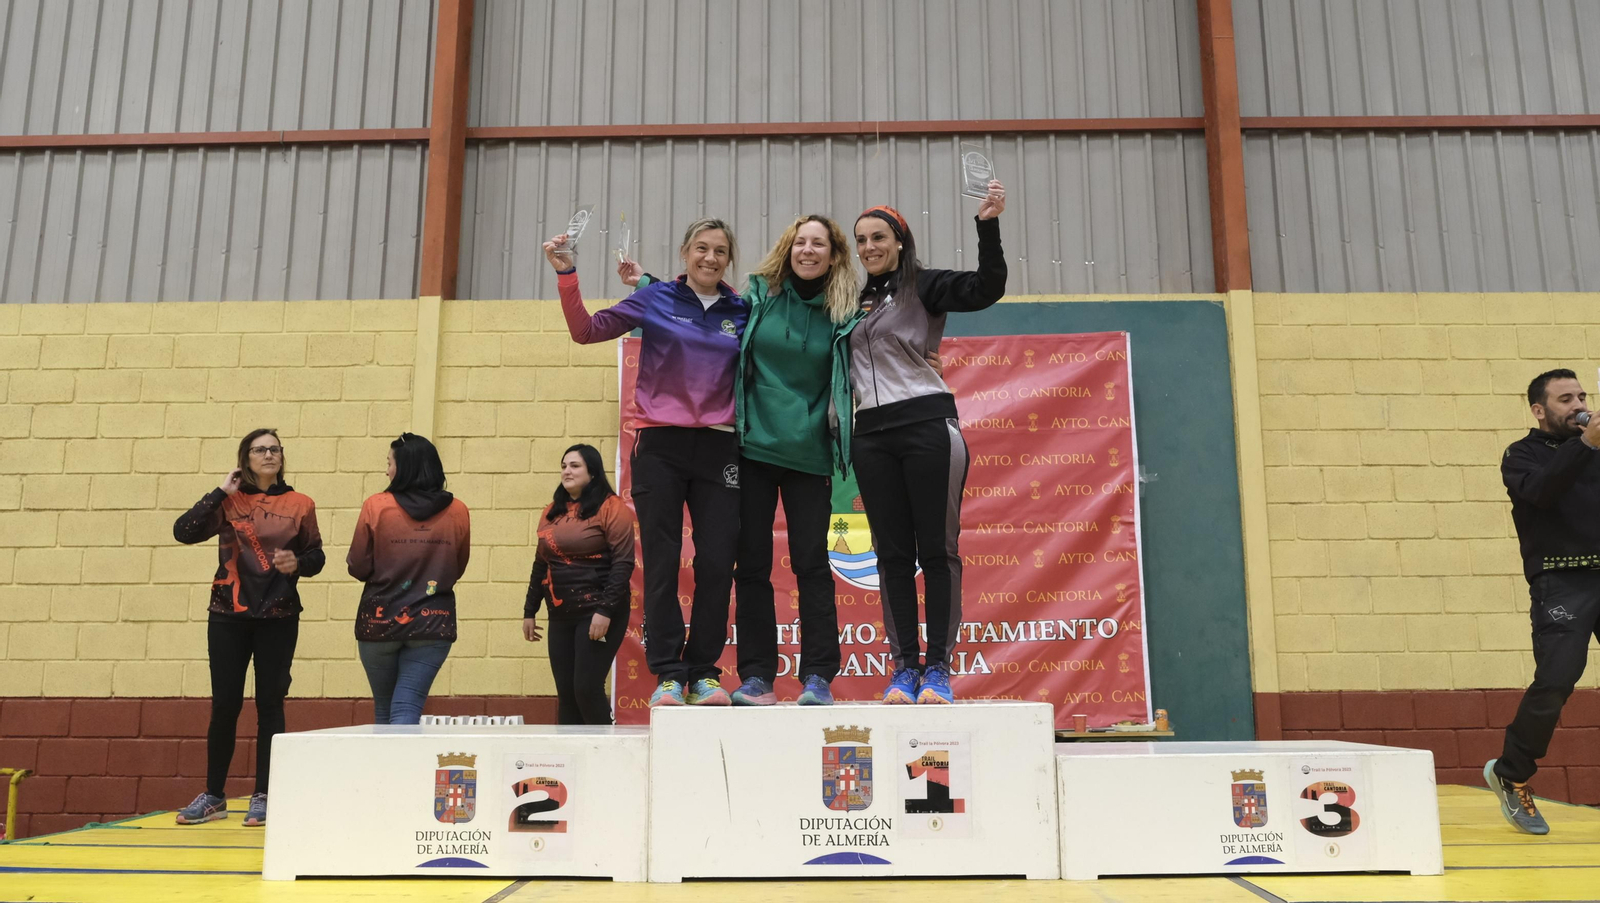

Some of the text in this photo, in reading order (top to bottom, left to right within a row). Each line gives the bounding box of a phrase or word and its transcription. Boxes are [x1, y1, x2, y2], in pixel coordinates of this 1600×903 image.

[940, 355, 1012, 367] CANTORIA
[1048, 352, 1088, 364] AYTO.
[972, 386, 1092, 402] AYTO. CANTORIA
[1052, 417, 1090, 428] AYTO.
[974, 453, 1096, 466] AYTO. CANTORIA
[1055, 484, 1095, 496] AYTO.
[976, 522, 1098, 534] AYTO. CANTORIA
[1058, 552, 1097, 564] AYTO.
[978, 590, 1102, 604] AYTO. CANTORIA
[1029, 660, 1105, 672] CANTORIA
[1064, 692, 1104, 704] AYTO.
[905, 750, 966, 814] 1
[508, 776, 568, 833] 2
[1300, 780, 1360, 838] 3
[800, 815, 892, 830] DIPUTACIÓN
[415, 829, 492, 841] DIPUTACIÓN
[802, 832, 890, 846] DE ALMERÍA
[1220, 831, 1283, 844] DIPUTACIÓN
[417, 842, 489, 855] DE ALMERÍA
[1223, 842, 1283, 854] DE ALMERÍA
